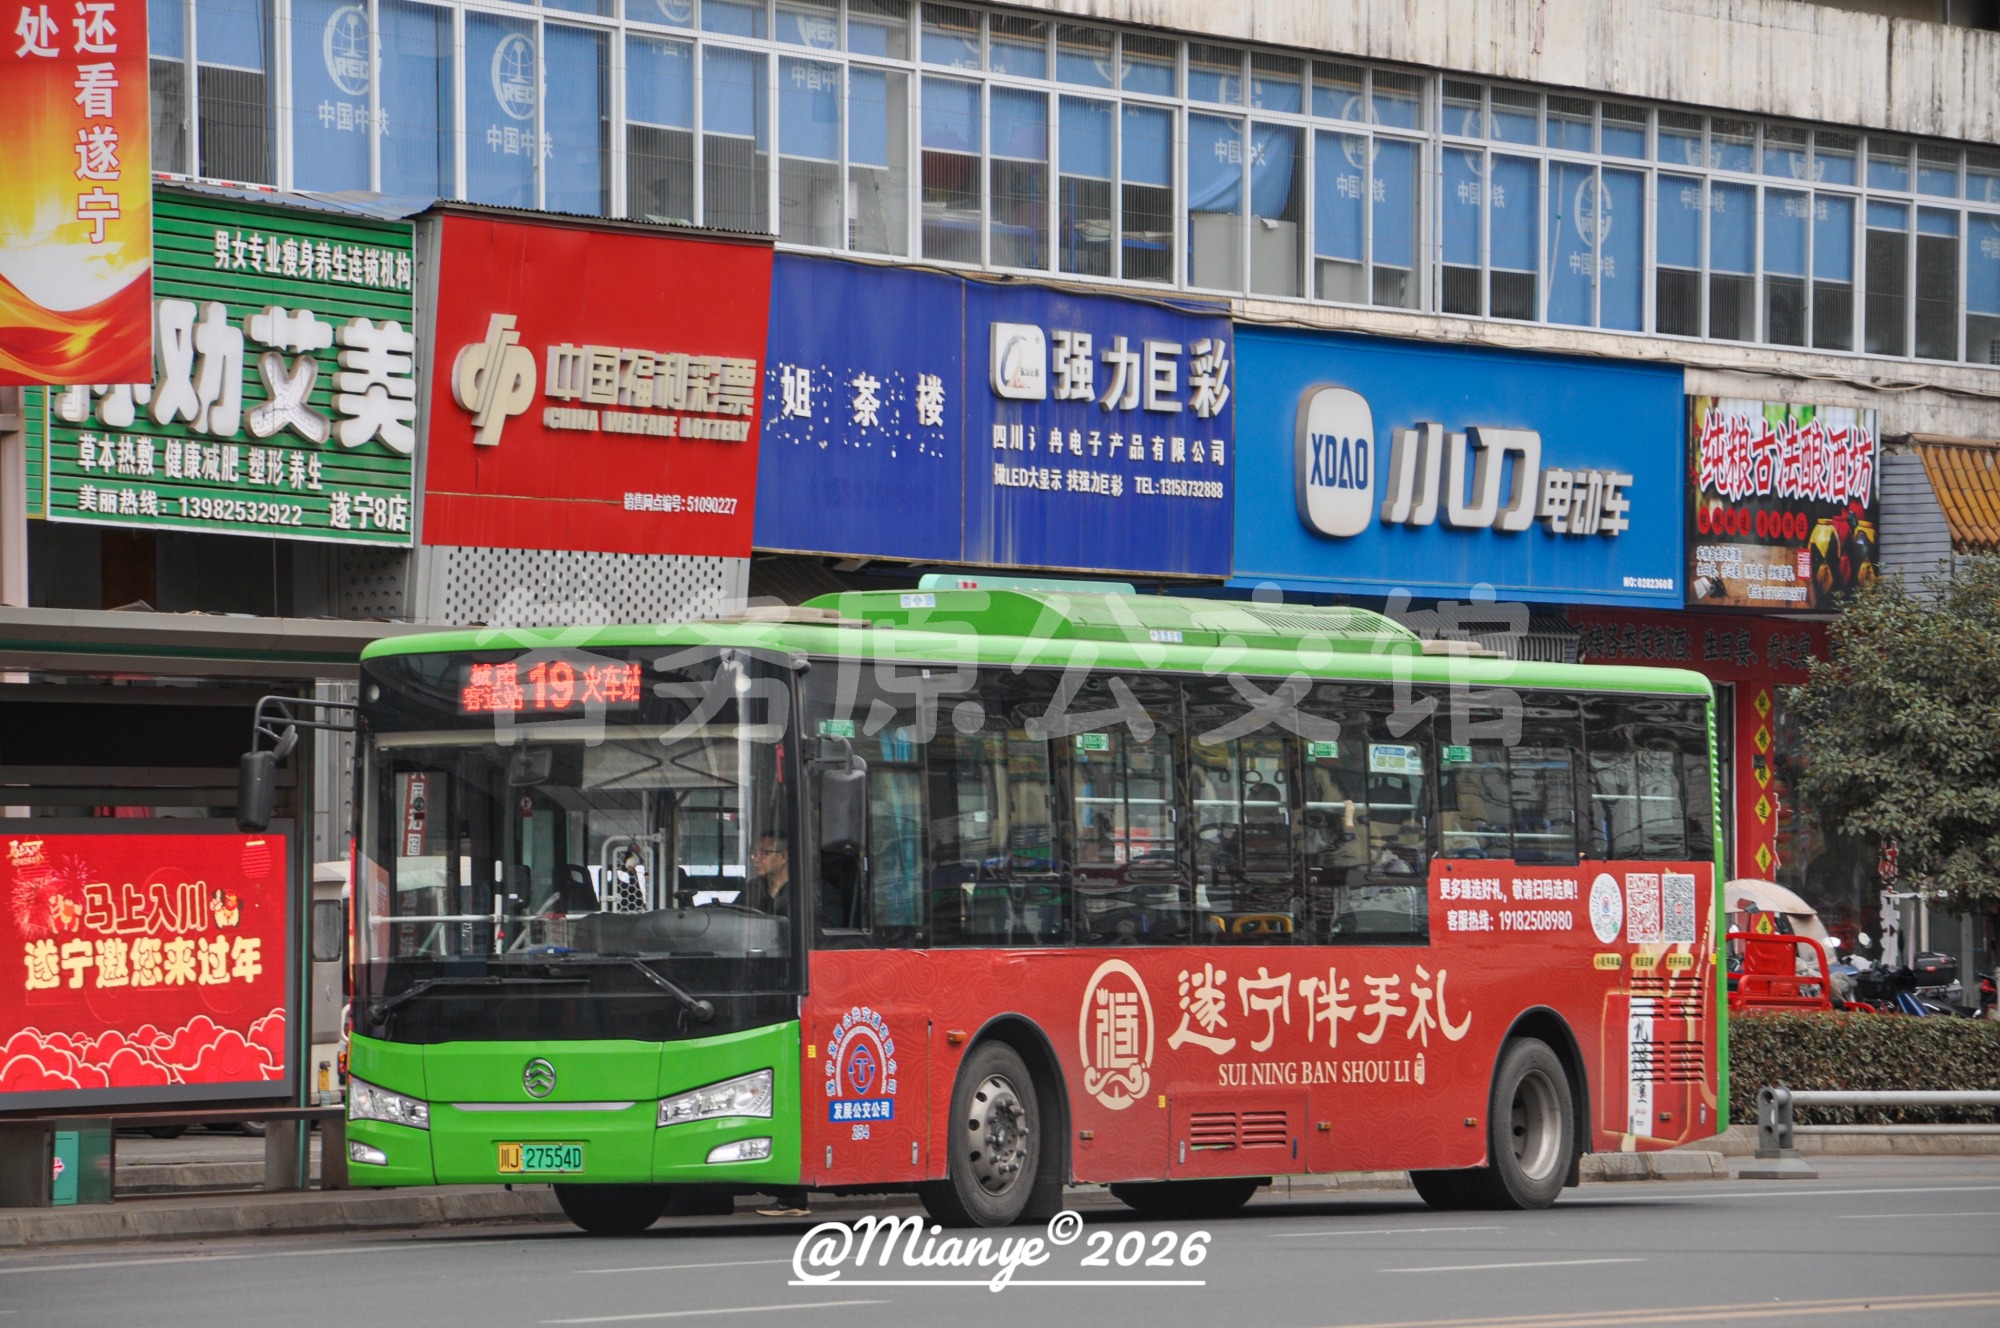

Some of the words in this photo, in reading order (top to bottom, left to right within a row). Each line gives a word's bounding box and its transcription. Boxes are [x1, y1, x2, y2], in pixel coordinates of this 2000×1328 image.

[15, 6, 60, 57] 处
[73, 2, 120, 244] 还看遂宁
[1336, 173, 1385, 202] 中国铁
[1457, 180, 1505, 208] 中国铁
[1681, 186, 1726, 213] 中国铁
[1785, 195, 1829, 221] 中国铁
[214, 230, 412, 290] 男女专业瘦身养生连锁机构
[1569, 251, 1616, 278] 中国铁
[545, 343, 757, 416] 中国福利彩票
[1051, 329, 1230, 418] 强力巨彩
[543, 407, 598, 431] CHINA
[602, 411, 677, 436] WELFARE
[679, 416, 750, 441] LOTTERY
[78, 433, 155, 477] 草本热敷
[164, 439, 239, 483] 健康减肥
[1310, 433, 1369, 490] XDAO
[1700, 408, 1874, 510] 纯粮古法酿酒坊
[329, 491, 409, 532] 遂宁8店
[1536, 467, 1633, 537] 电动车
[464, 686, 524, 711] 客运站
[529, 662, 574, 709] 19
[582, 665, 641, 702] 火车站
[84, 881, 208, 935] 马上入川
[25, 935, 263, 990] 遂宁邀您来过年
[1168, 962, 1472, 1055] 遂宁伴手礼
[1218, 1063, 1250, 1086] SUI
[1252, 1061, 1297, 1086] NING
[1301, 1060, 1338, 1084] BAN
[1343, 1060, 1391, 1084] SHOU
[1394, 1059, 1411, 1083] LI
[833, 1101, 890, 1120] 发展公交公司
